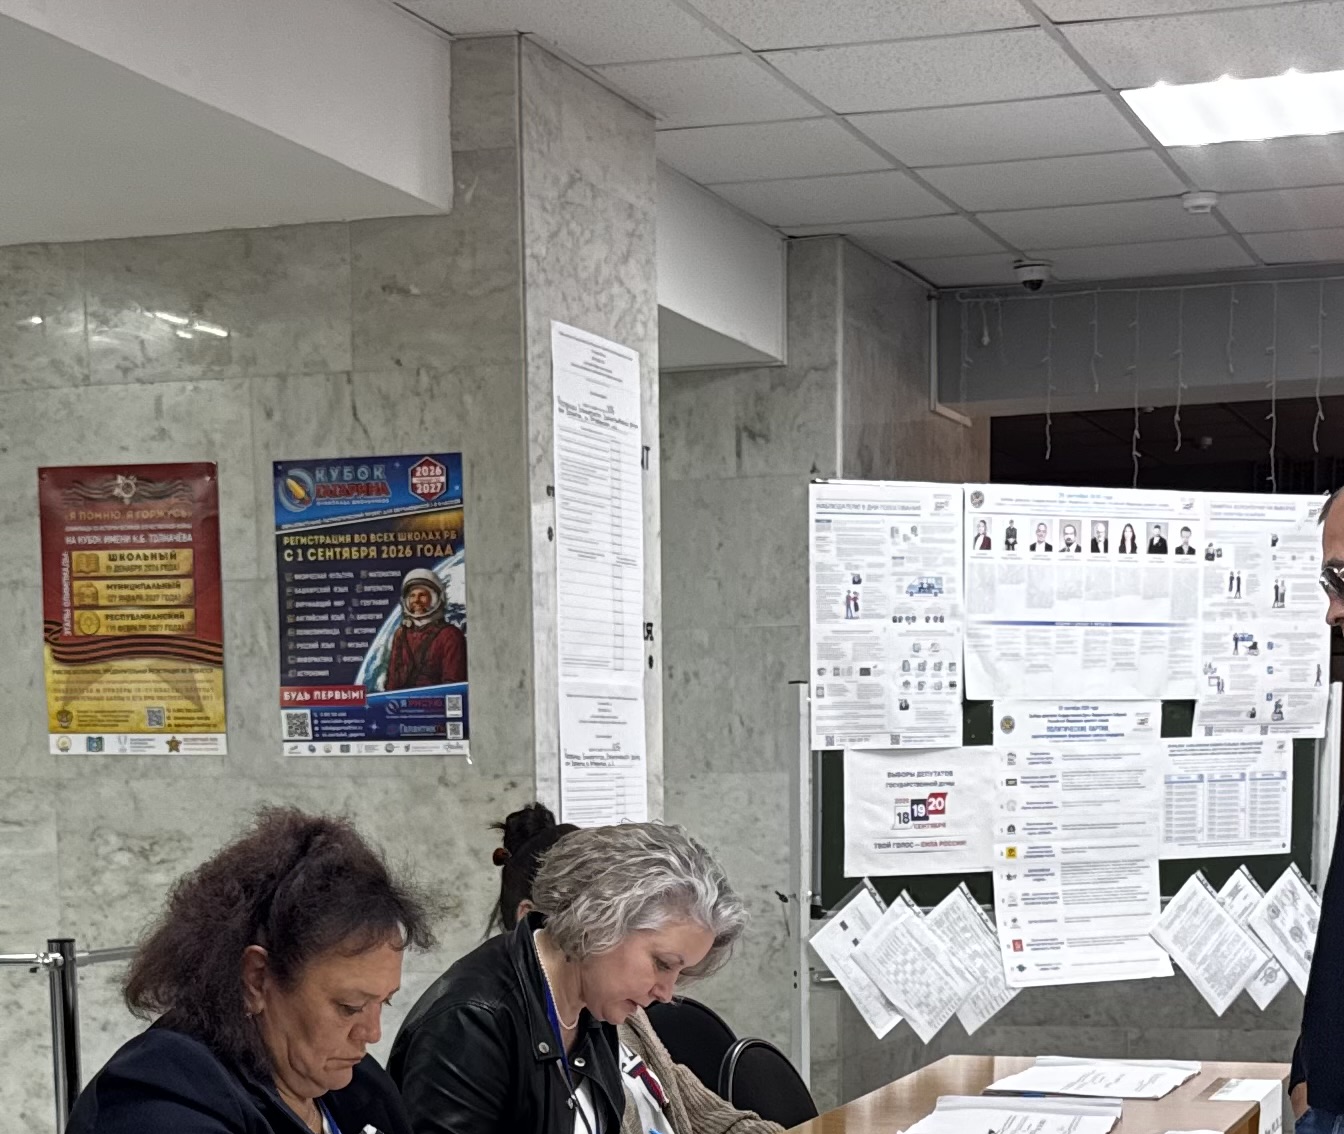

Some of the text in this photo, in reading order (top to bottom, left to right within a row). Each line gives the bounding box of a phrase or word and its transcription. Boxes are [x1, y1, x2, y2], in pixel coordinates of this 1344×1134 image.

[315, 465, 385, 481] КУБОК
[415, 466, 442, 476] 2026
[416, 485, 441, 494] 2027
[283, 536, 351, 546] РЕГИСТРАЦИЯ
[354, 535, 367, 544] ВО
[370, 533, 395, 543] ВСЕХ
[397, 531, 441, 542] ШКОЛАХ
[108, 552, 177, 562] ШКОЛЬНЫЙ
[284, 544, 454, 561] С 1 СЕНТЯБРЯ 2026 ГОДА
[284, 689, 363, 701] БУДЬ ПЕРВЫМ!
[912, 804, 925, 817] 19
[928, 798, 944, 811] 20
[897, 812, 910, 825] 18
